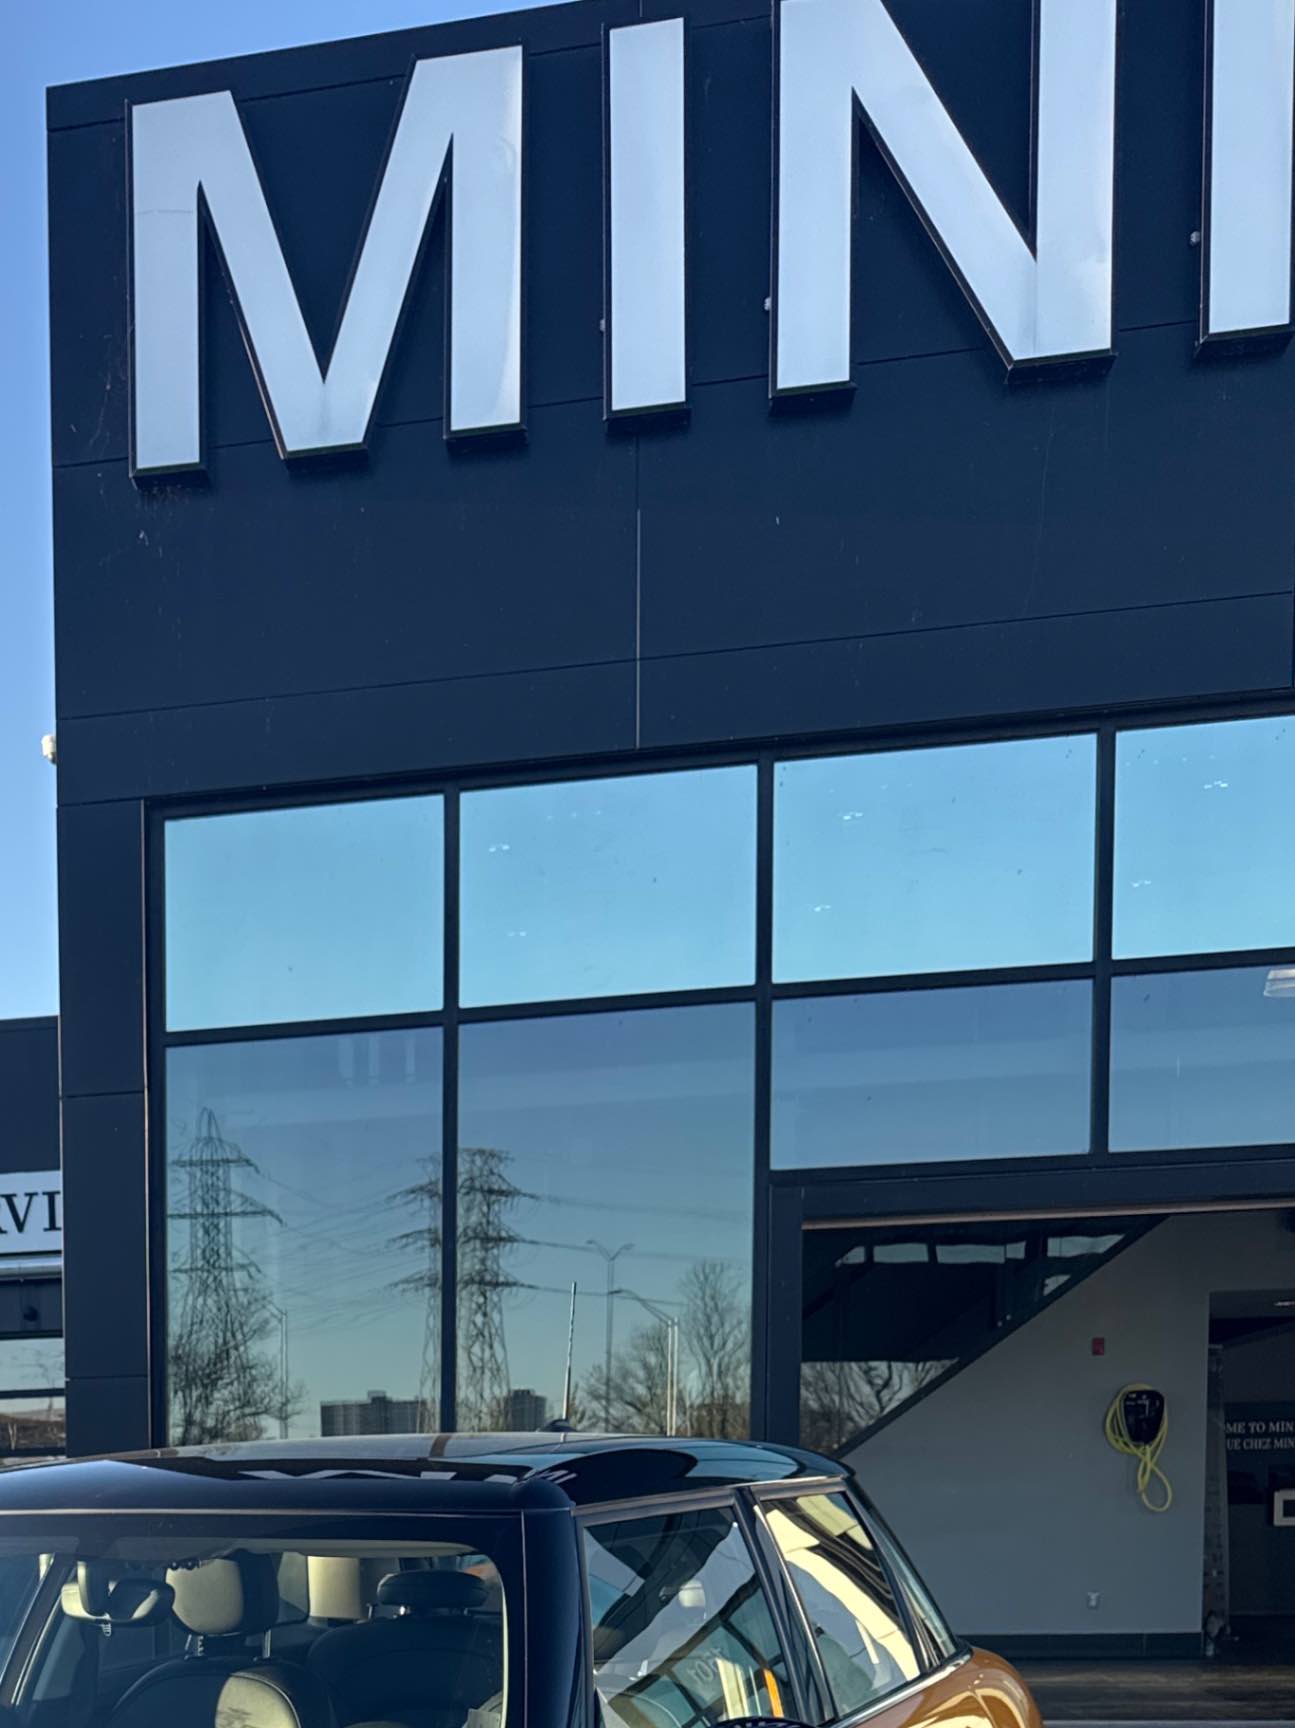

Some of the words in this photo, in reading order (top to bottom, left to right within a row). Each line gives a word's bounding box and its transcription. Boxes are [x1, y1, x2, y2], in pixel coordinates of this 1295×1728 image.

[129, 0, 1292, 475] MINI
[1248, 1421, 1266, 1433] TO
[1242, 1437, 1271, 1450] CHEZ
